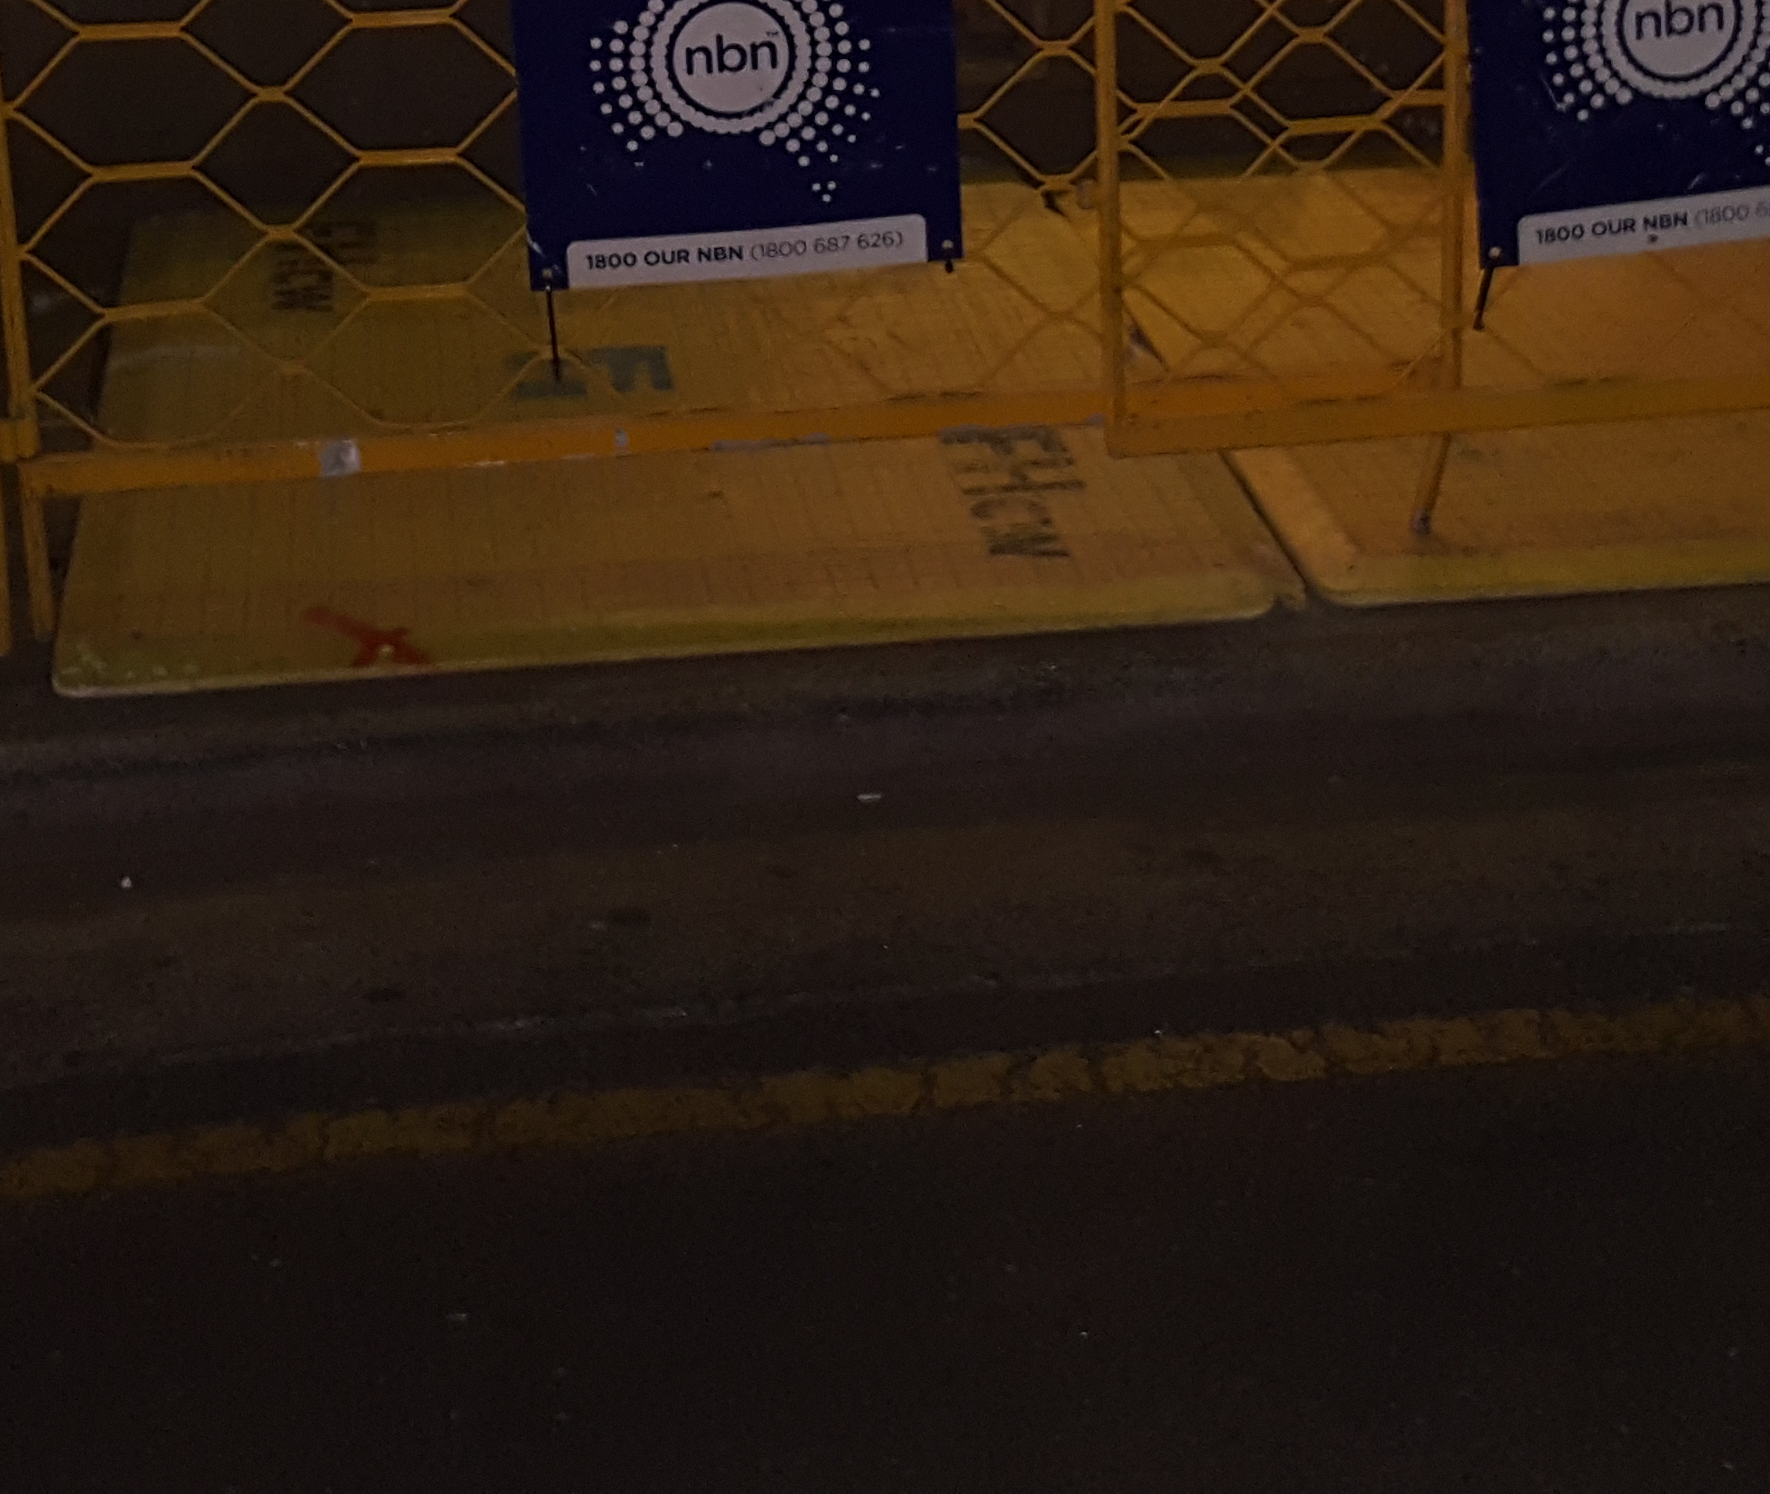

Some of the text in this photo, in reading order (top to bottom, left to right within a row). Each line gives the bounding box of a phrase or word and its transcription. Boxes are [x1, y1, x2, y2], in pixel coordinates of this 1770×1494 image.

[685, 33, 778, 75] nbn
[1535, 224, 1584, 245] 1800
[1591, 217, 1636, 237] OUR
[1643, 212, 1688, 231] NBN
[586, 230, 903, 270] 1800 OUR NBN (1800 687 626)
